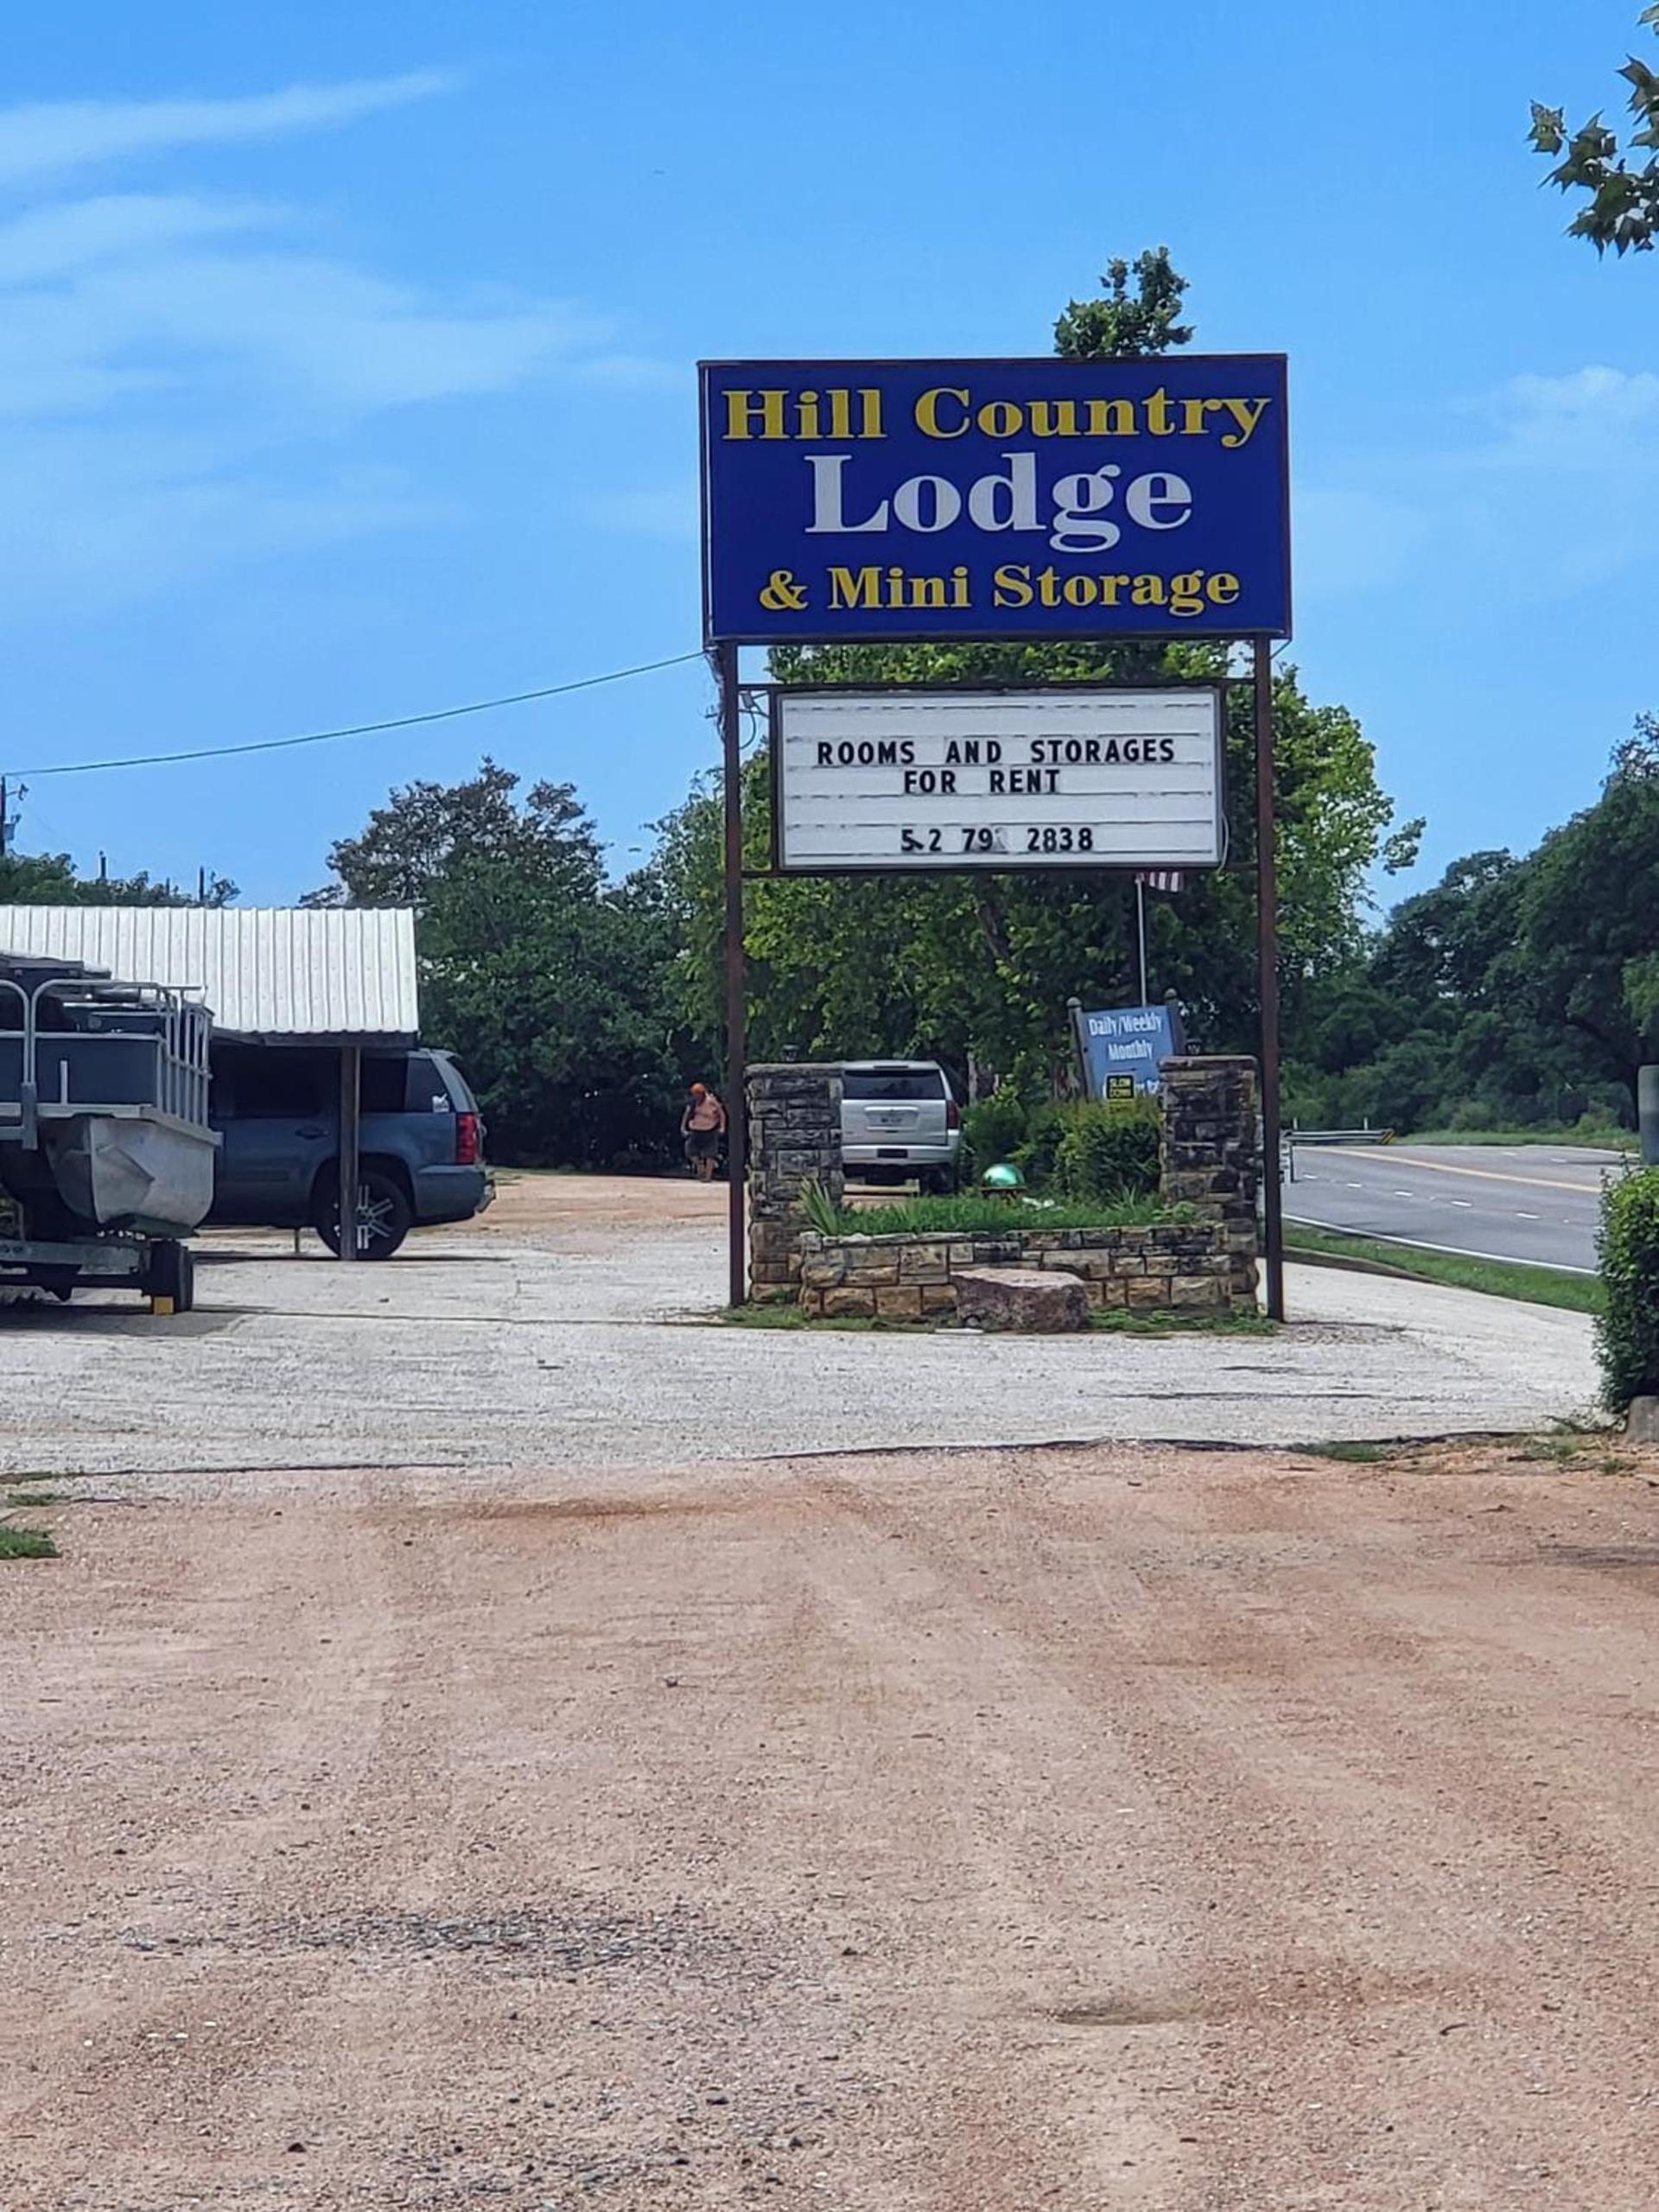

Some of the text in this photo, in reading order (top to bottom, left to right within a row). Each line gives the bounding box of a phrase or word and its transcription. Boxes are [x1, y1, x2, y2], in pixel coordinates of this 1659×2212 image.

[722, 386, 1272, 448] Hill Country
[804, 452, 1192, 553] Lodge
[759, 564, 1240, 617] & Mini Storage
[818, 739, 1174, 765] ROOMS AND STORAGES
[904, 769, 1060, 793] FOR RENT
[1027, 827, 1093, 852] 2838
[1108, 1039, 1153, 1061] Monthly
